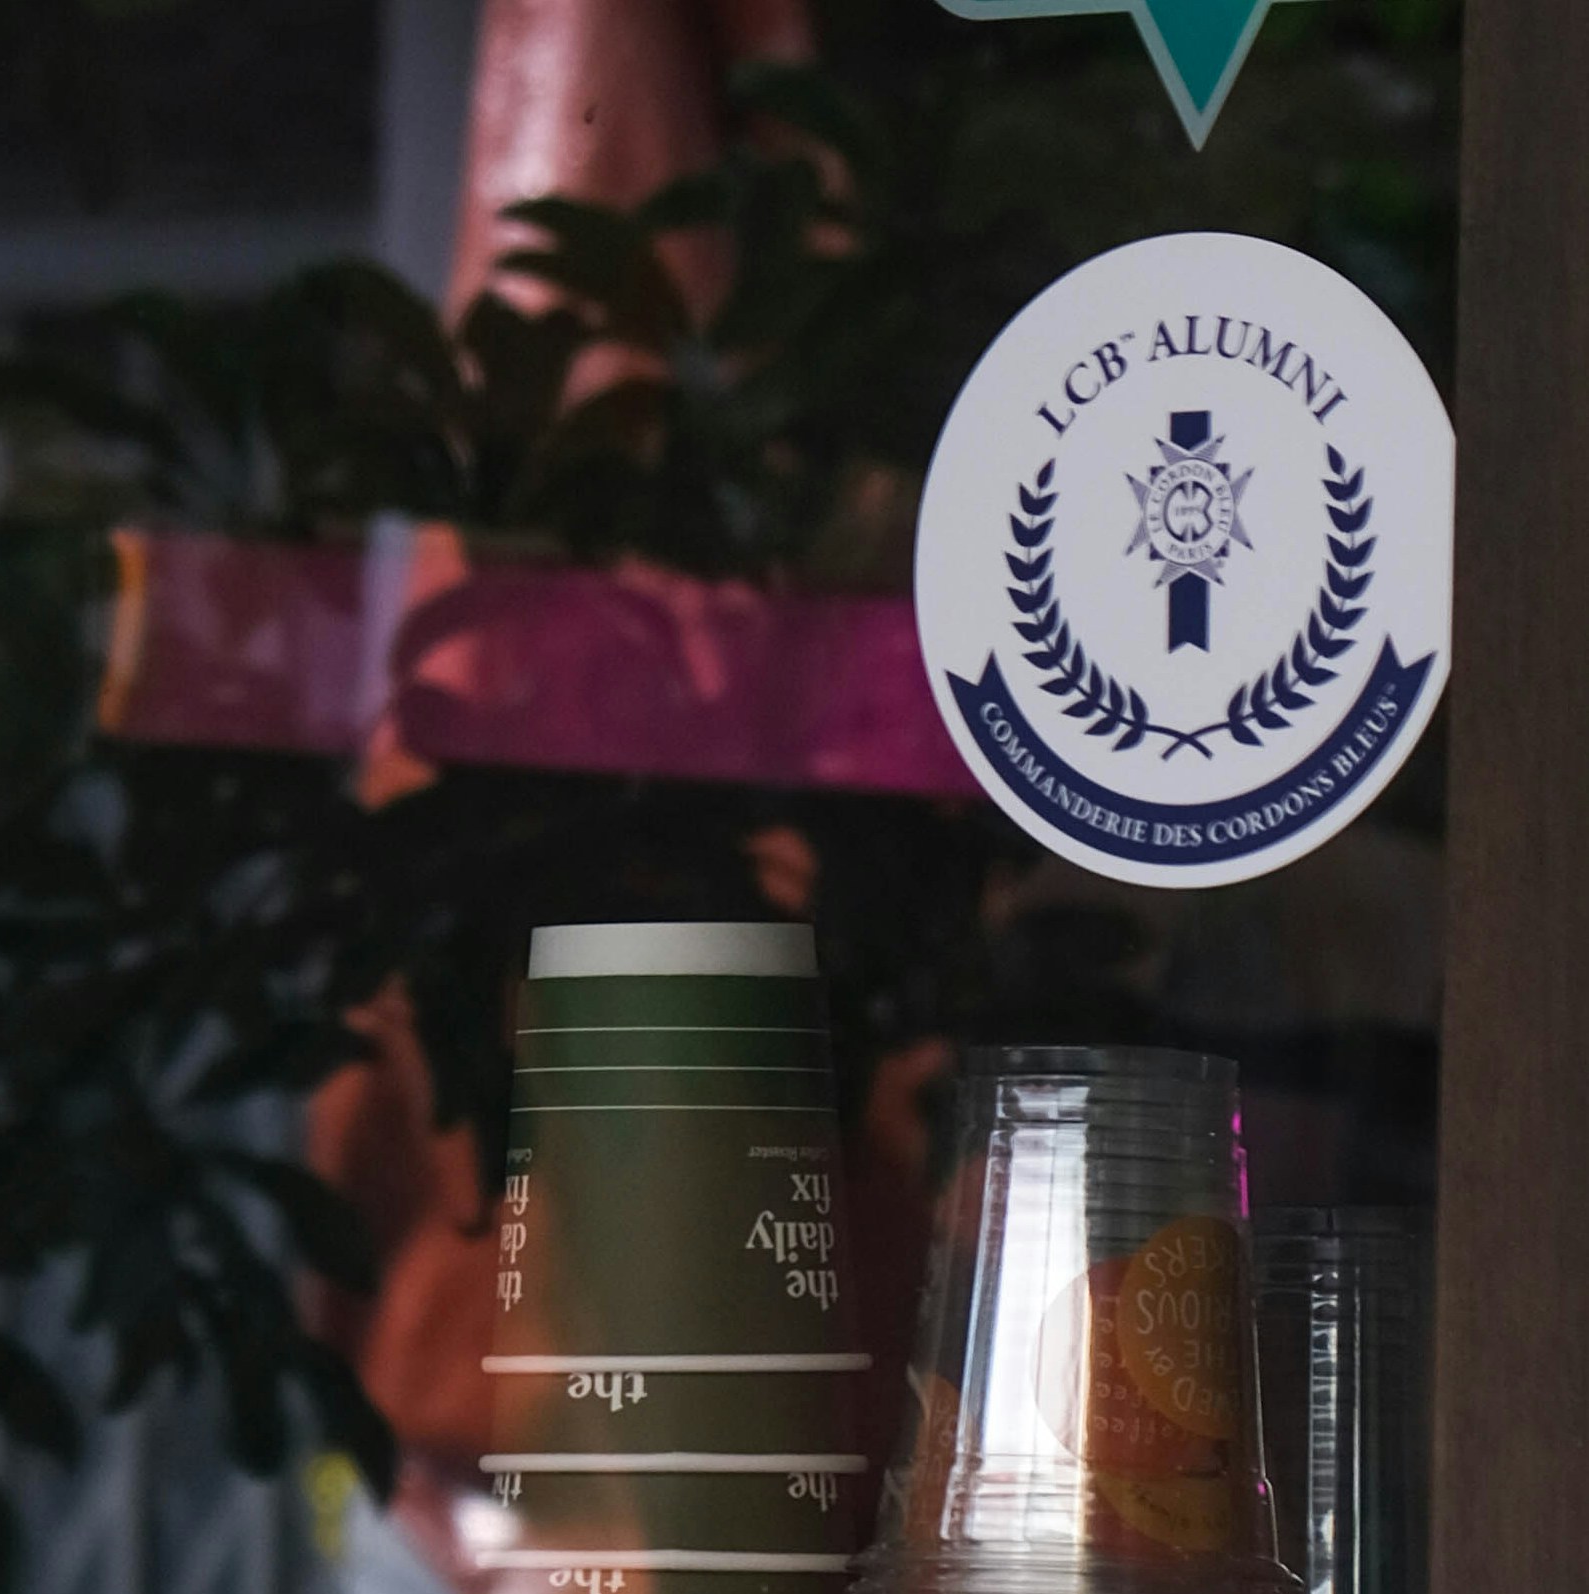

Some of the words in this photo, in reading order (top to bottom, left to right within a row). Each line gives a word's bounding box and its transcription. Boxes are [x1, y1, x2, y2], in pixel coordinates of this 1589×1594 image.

[1147, 315, 1348, 424] ALUMNI
[979, 701, 1147, 845] COMMANDERIE
[1153, 818, 1203, 846] DES
[1210, 770, 1335, 846] CORDONS
[792, 1174, 831, 1215] fix
[745, 1211, 835, 1263] daily
[497, 1271, 522, 1312] th
[786, 1269, 839, 1312] the
[567, 1373, 648, 1412] the
